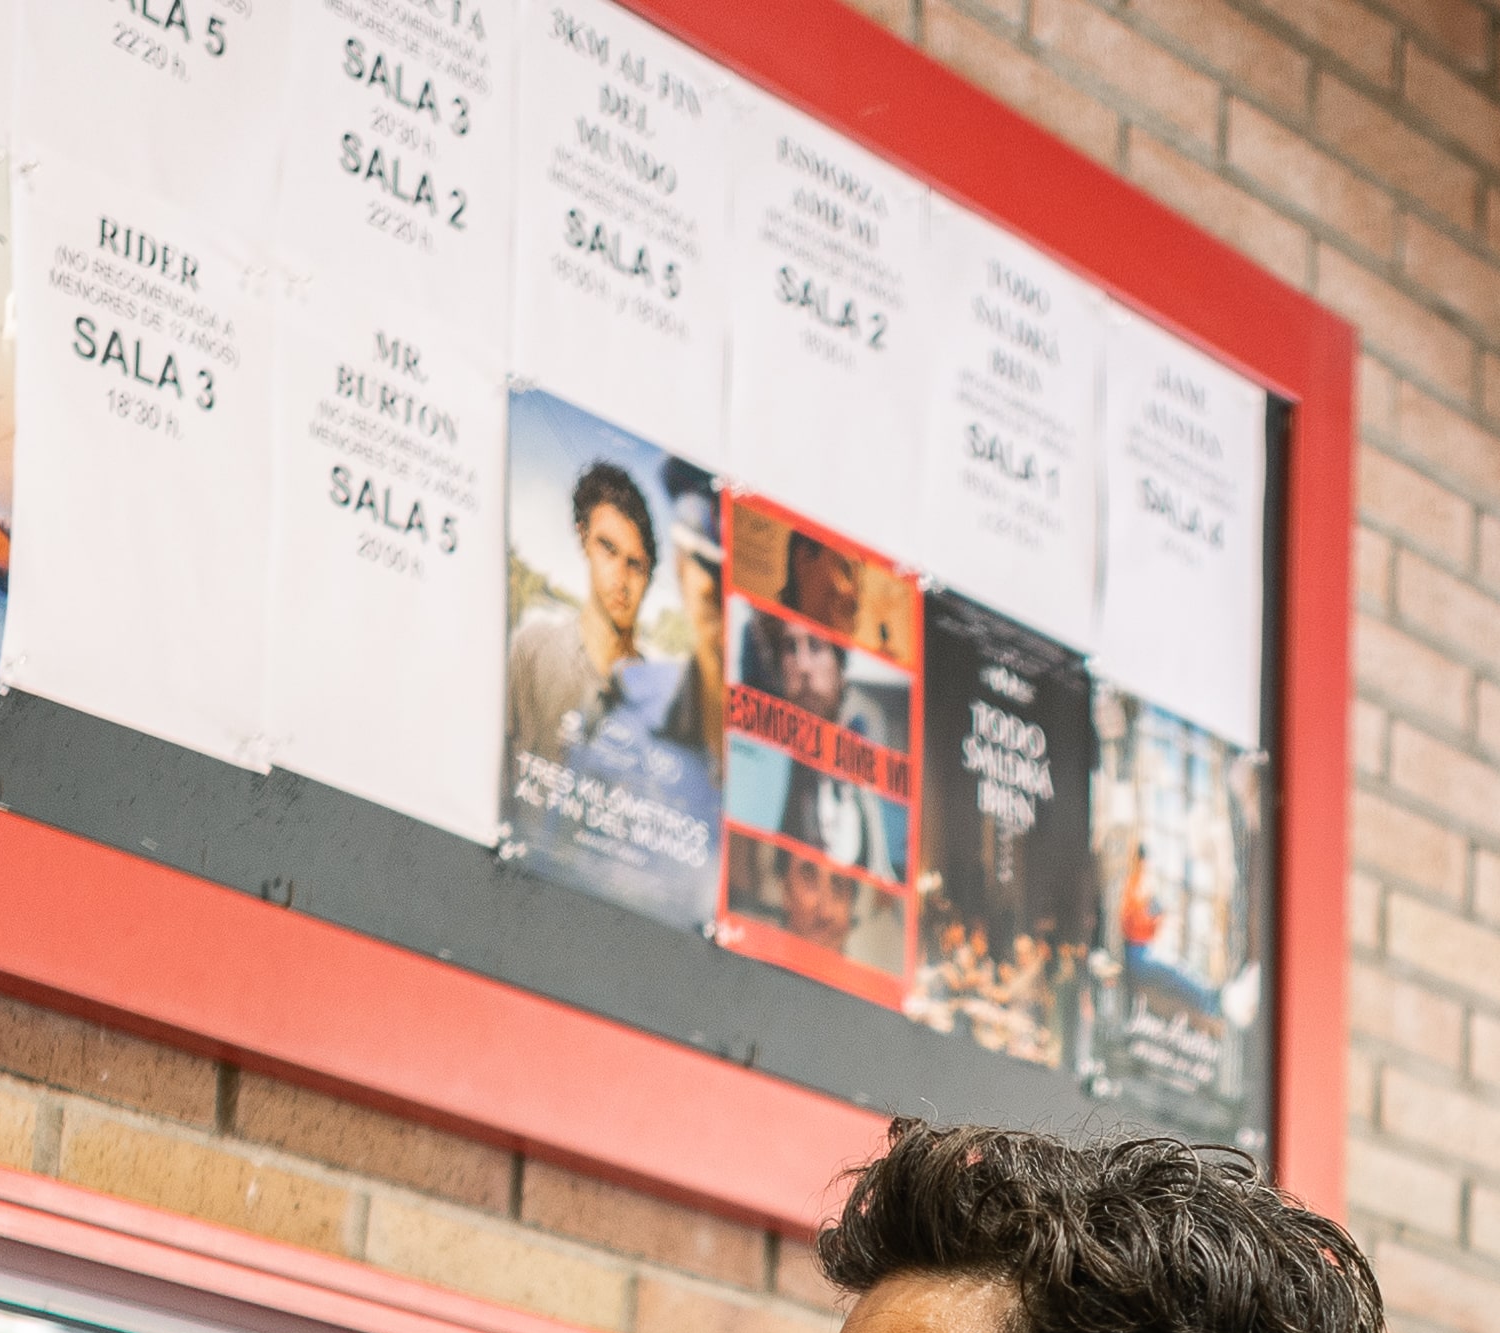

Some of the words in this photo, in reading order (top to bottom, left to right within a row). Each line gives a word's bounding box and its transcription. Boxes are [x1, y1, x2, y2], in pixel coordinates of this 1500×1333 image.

[205, 15, 226, 57] 5
[343, 37, 441, 124] SALA
[451, 97, 469, 137] 3
[340, 131, 437, 217] SALA
[449, 189, 467, 230] 2
[576, 114, 677, 195] MUNDO
[98, 216, 200, 292] RIDER
[564, 208, 654, 287] SALA
[662, 261, 681, 299] 5
[49, 268, 137, 320] MENORES
[141, 306, 164, 332] DE
[92, 259, 219, 328] RECOMENDADA
[774, 265, 861, 338] SALA
[868, 312, 889, 352] 2
[73, 315, 184, 399] SALA
[196, 369, 215, 410] 3
[107, 388, 162, 431] 18'30
[336, 363, 459, 446] BURTON
[965, 423, 1040, 489] SALA
[330, 464, 429, 544] SALA
[441, 515, 458, 555] 5
[970, 700, 1047, 759] TODO
[517, 749, 575, 795] TRES
